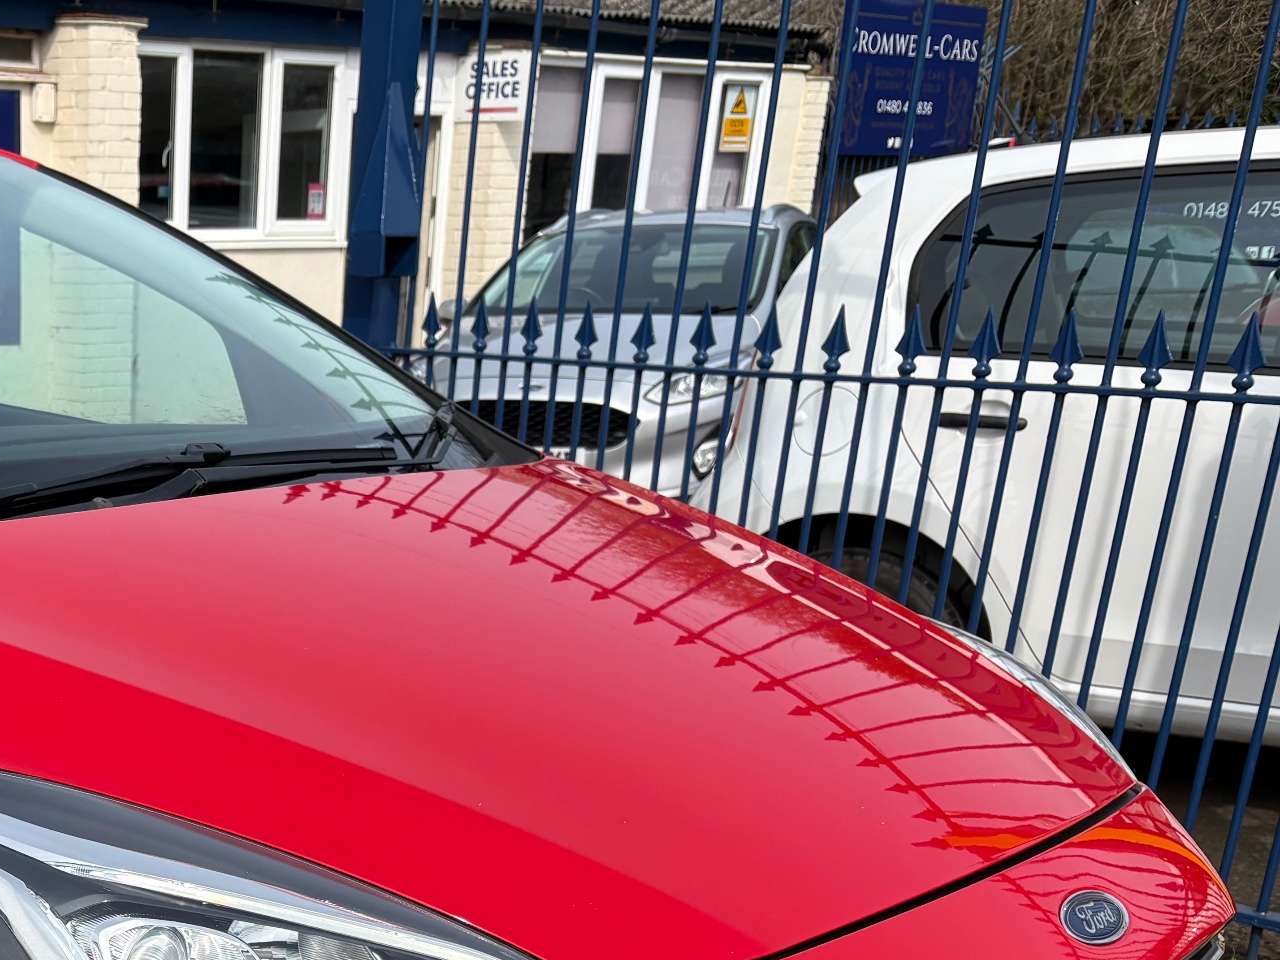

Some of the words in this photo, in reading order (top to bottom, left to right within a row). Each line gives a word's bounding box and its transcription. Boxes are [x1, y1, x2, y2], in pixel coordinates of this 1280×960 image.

[851, 27, 979, 62] ROMWEL-CARS
[469, 60, 519, 79] SALES
[465, 81, 520, 99] OFFICE
[876, 99, 902, 114] 01480
[902, 100, 933, 115] 4836
[1183, 202, 1241, 218] 0148
[1075, 901, 1118, 933] Ford
